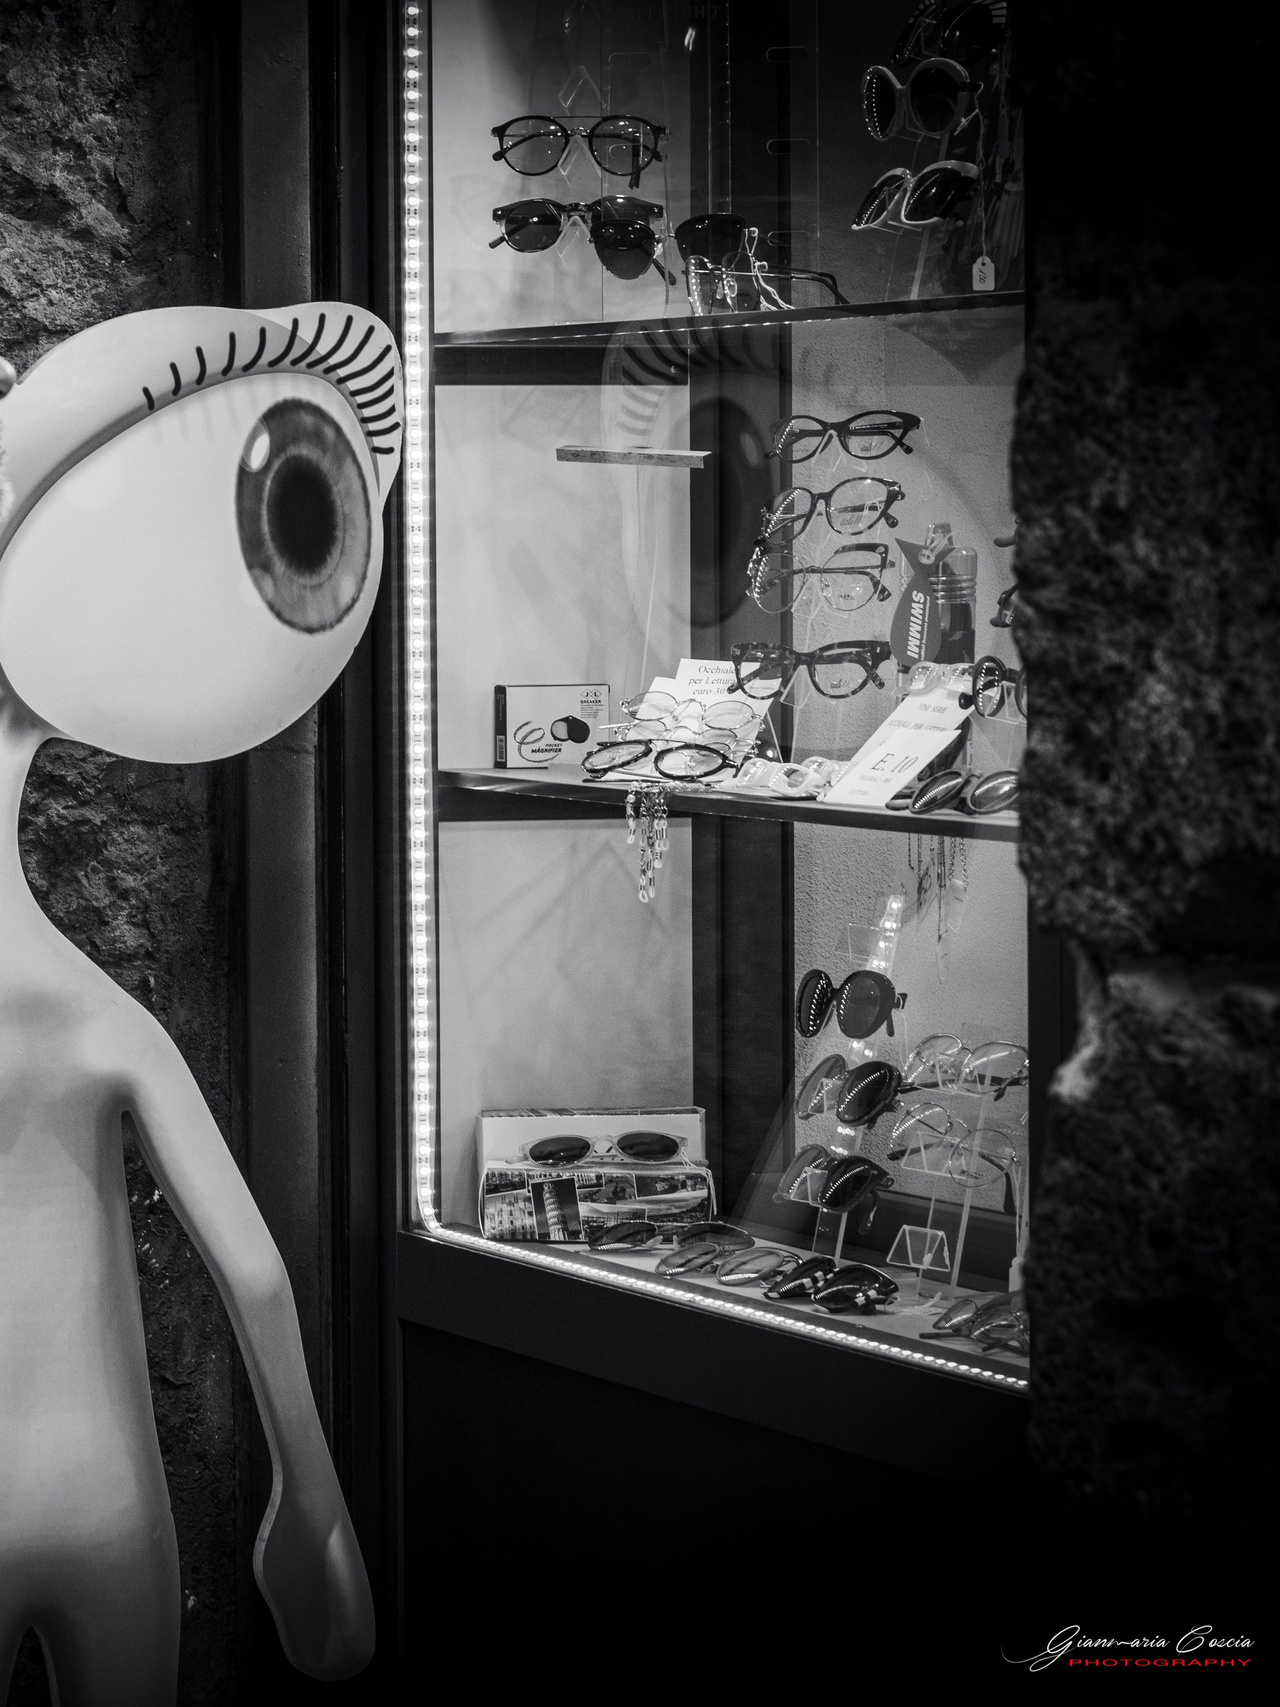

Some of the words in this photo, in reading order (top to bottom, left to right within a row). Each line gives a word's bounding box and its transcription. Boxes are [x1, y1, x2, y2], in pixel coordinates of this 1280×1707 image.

[907, 590, 925, 659] SWIMMI
[688, 678, 704, 686] per
[705, 677, 736, 685] Lettura
[714, 687, 726, 695] 30
[890, 755, 919, 773] 10
